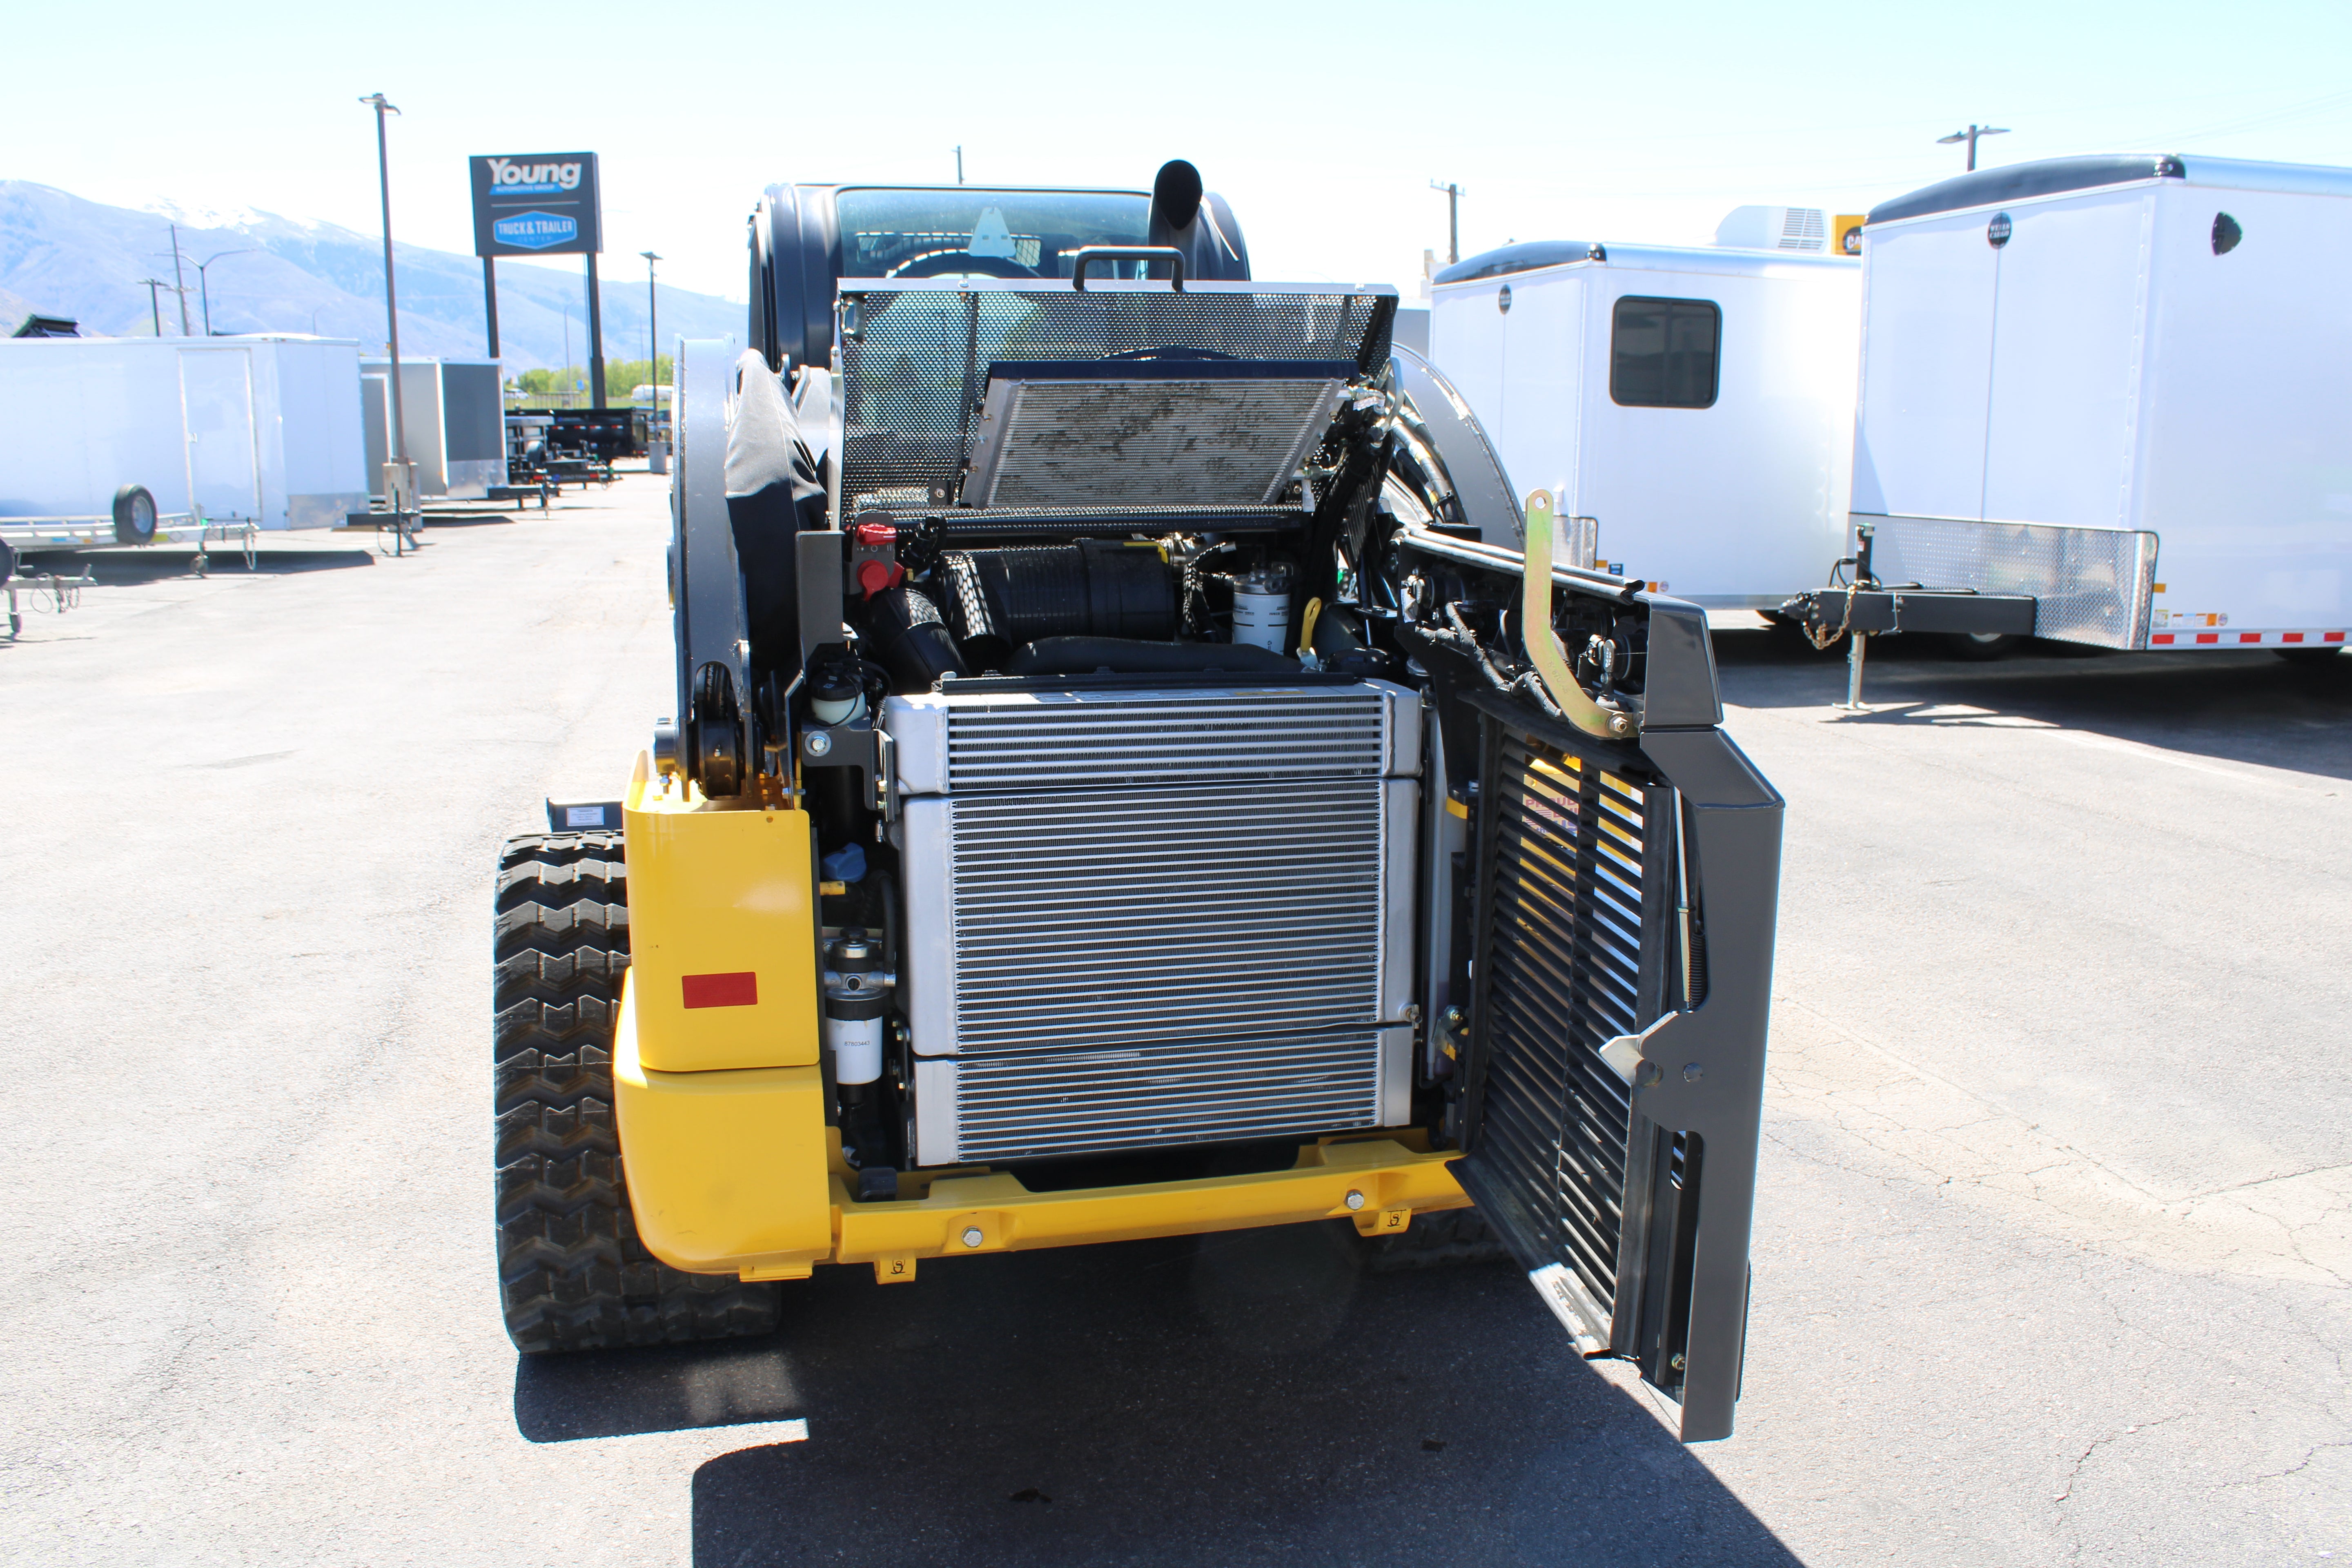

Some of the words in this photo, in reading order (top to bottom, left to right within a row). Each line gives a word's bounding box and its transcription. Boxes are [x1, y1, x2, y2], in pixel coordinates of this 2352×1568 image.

[487, 158, 582, 190] Young
[498, 223, 526, 235] TRUCK
[526, 221, 535, 234] &
[535, 220, 572, 234] TRAILER
[1989, 230, 2009, 239] CARGO
[1846, 234, 1861, 249] CA
